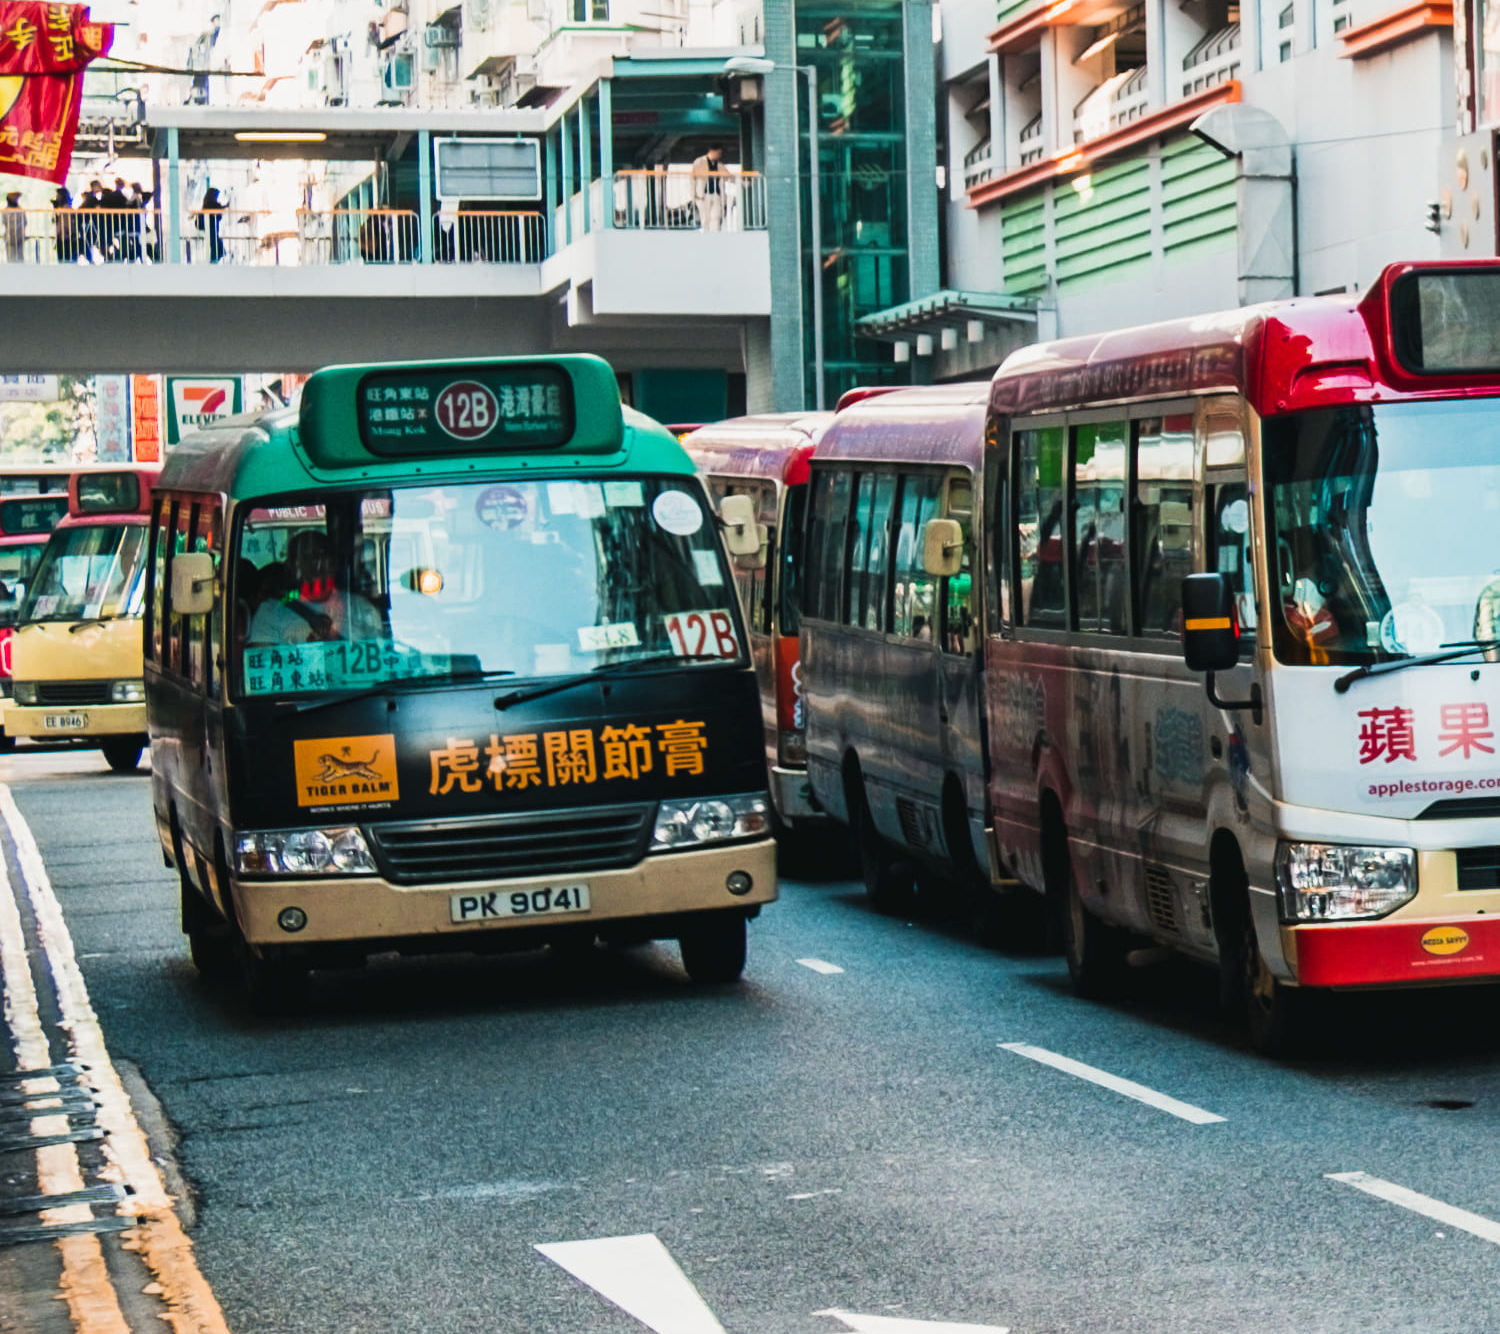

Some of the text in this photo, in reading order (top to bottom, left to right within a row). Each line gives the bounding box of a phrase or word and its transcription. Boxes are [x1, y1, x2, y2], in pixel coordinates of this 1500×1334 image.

[443, 391, 490, 429] 12B
[667, 610, 736, 659] 12B
[428, 719, 708, 797] 虎標關節膏
[306, 782, 391, 797] TIGER BALM
[460, 887, 582, 917] PK 9041
